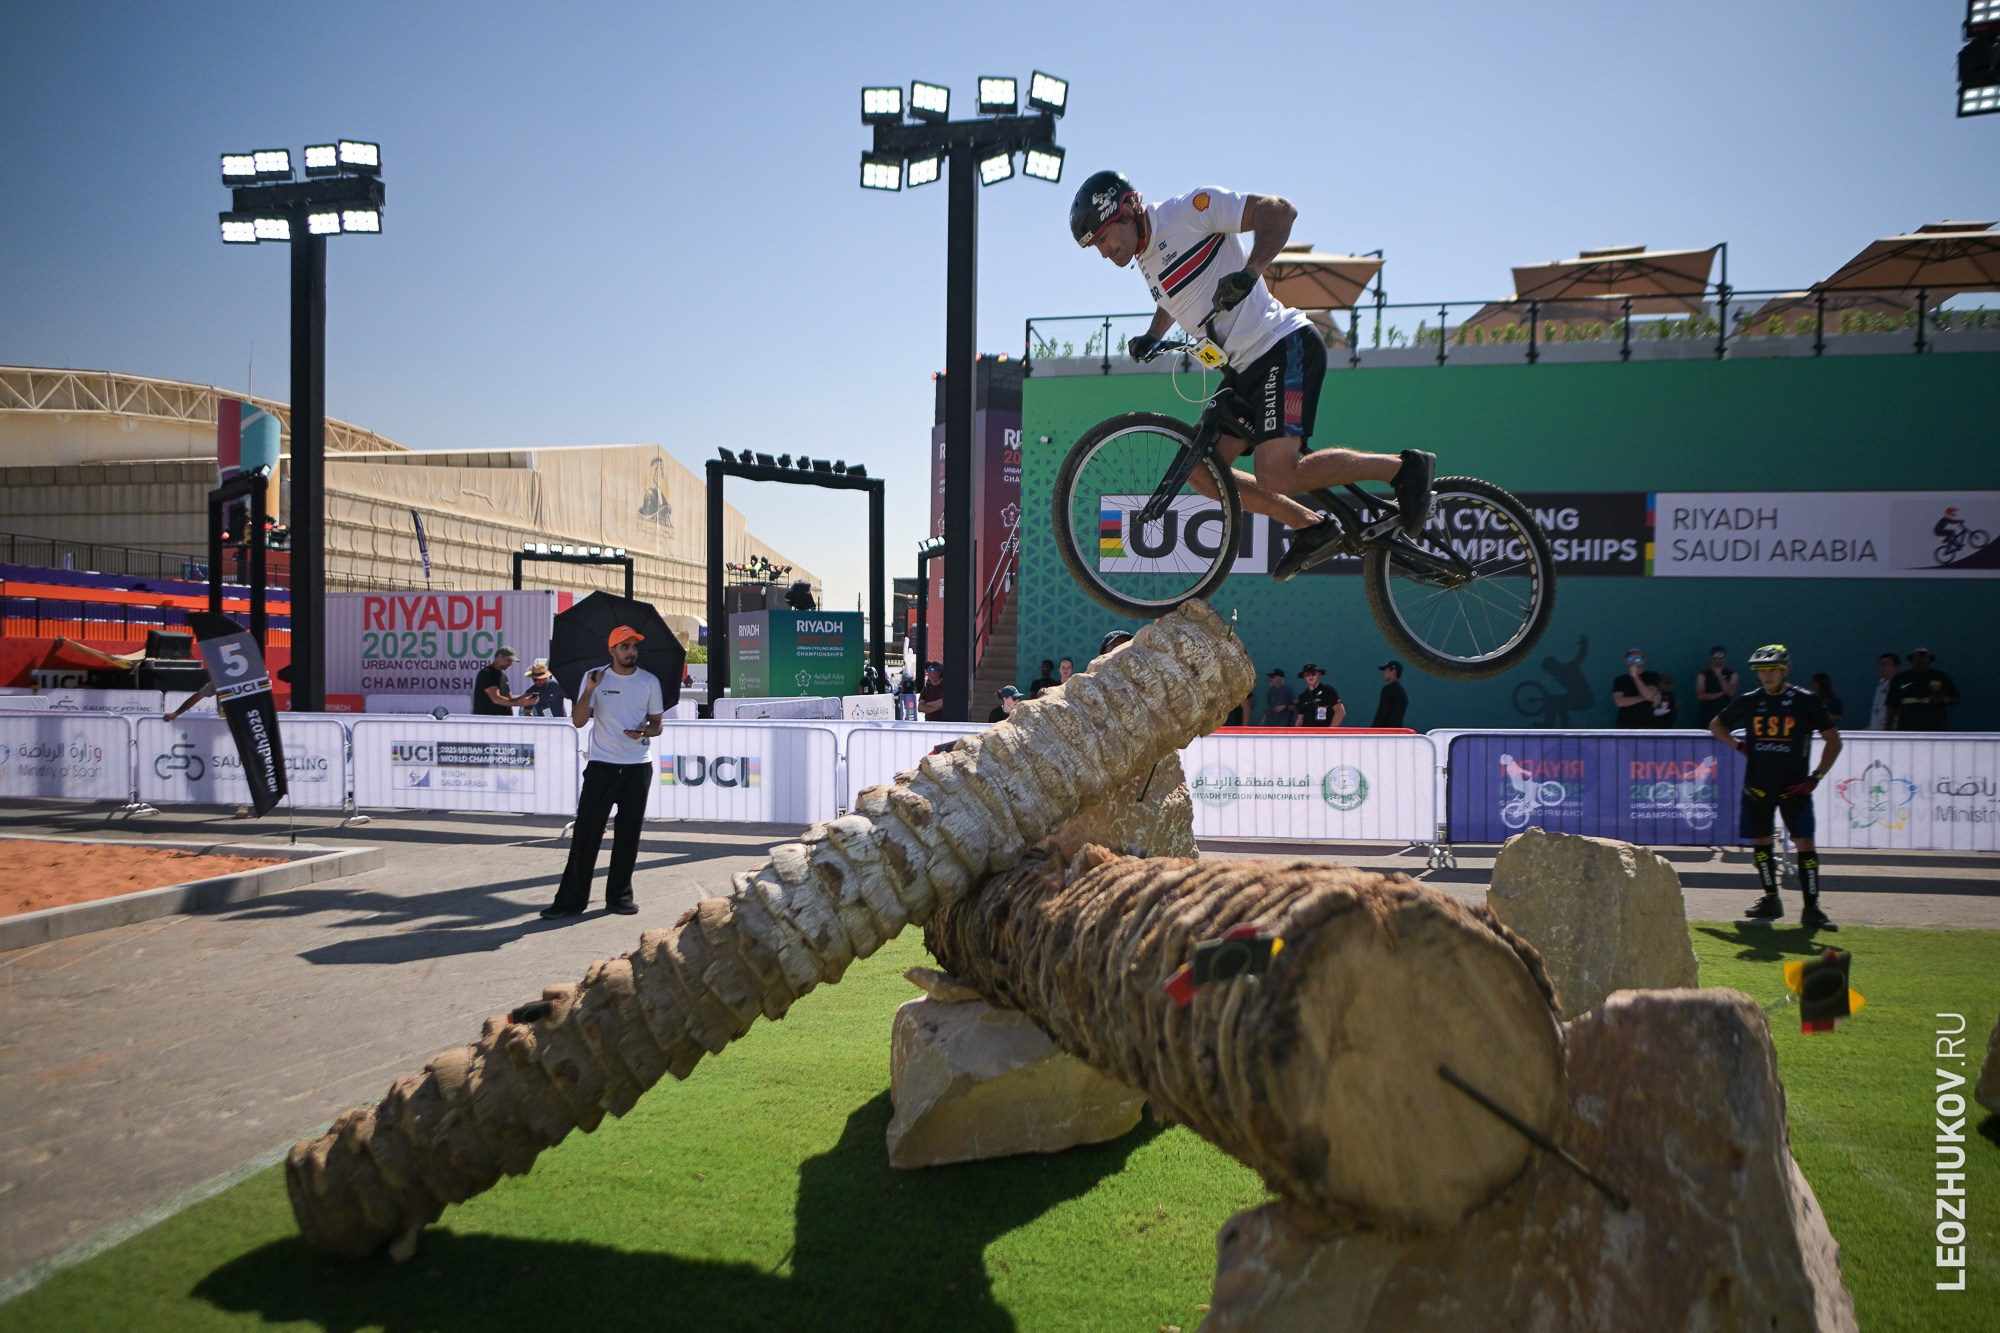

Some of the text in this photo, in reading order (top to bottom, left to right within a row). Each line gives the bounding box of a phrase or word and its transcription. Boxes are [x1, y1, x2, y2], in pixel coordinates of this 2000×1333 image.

[1673, 507, 1777, 530] RIYADH
[1130, 509, 1254, 558] UCI
[1672, 539, 1878, 562] SAUDI ARABIA
[363, 595, 503, 631] RIYADH
[738, 624, 760, 637] RIYADH
[797, 619, 843, 633] RIYADH
[362, 632, 438, 660] 2025
[219, 643, 249, 677] 5
[362, 660, 402, 670] URBAN
[405, 660, 456, 671] CYCLING
[231, 683, 257, 695] UCI
[1753, 715, 1796, 737] ESP
[400, 745, 434, 762] UCI
[440, 746, 516, 755] 2025 URBAN CYCLING
[440, 755, 531, 765] WORLD CHAMPIONSHIPS
[441, 770, 466, 778] RIYADH
[675, 756, 751, 788] UCI
[1630, 760, 1717, 780] RIYADH
[1191, 792, 1222, 800] RIYADH
[1222, 793, 1252, 801] REGION
[1253, 793, 1311, 801] MUNICIPALITY
